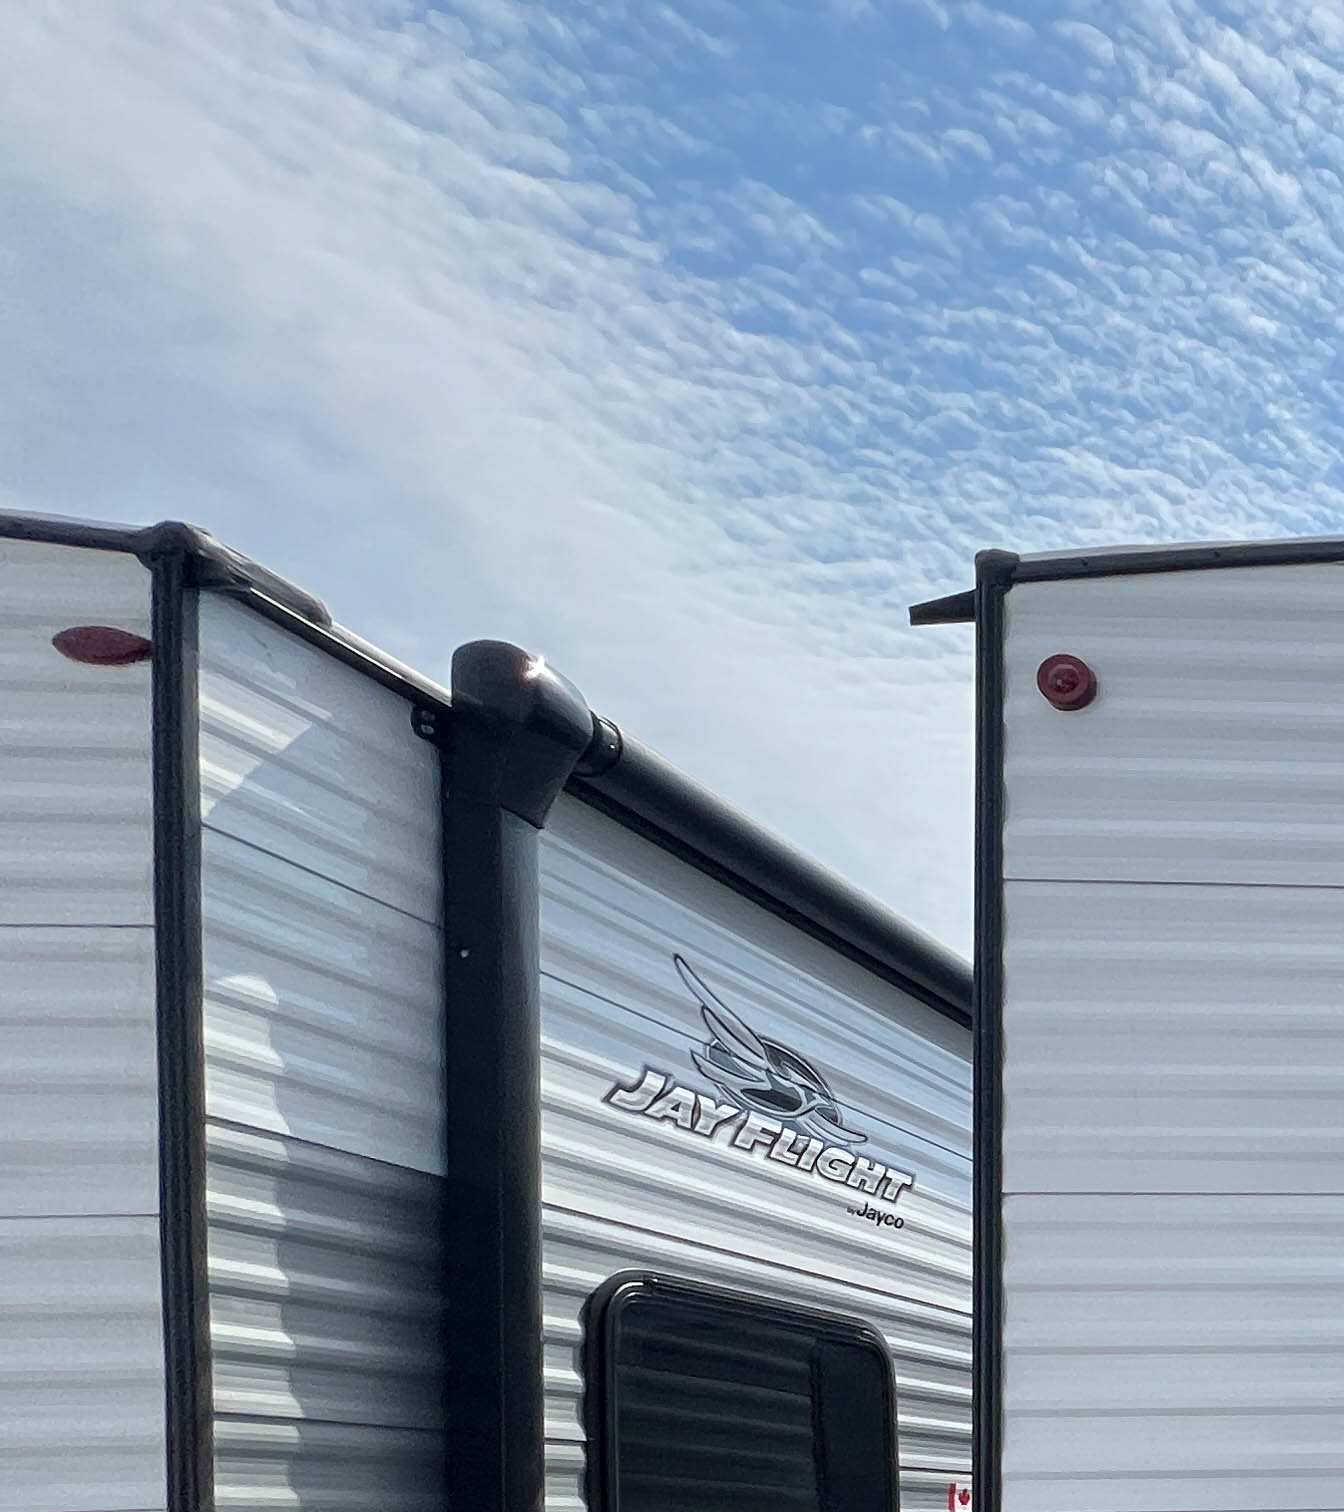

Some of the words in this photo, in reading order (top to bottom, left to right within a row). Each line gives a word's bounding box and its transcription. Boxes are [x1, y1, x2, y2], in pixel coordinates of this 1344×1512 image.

[604, 1063, 744, 1139] JAY
[731, 1110, 916, 1203] FLIGHT
[856, 1202, 905, 1229] Jayco
